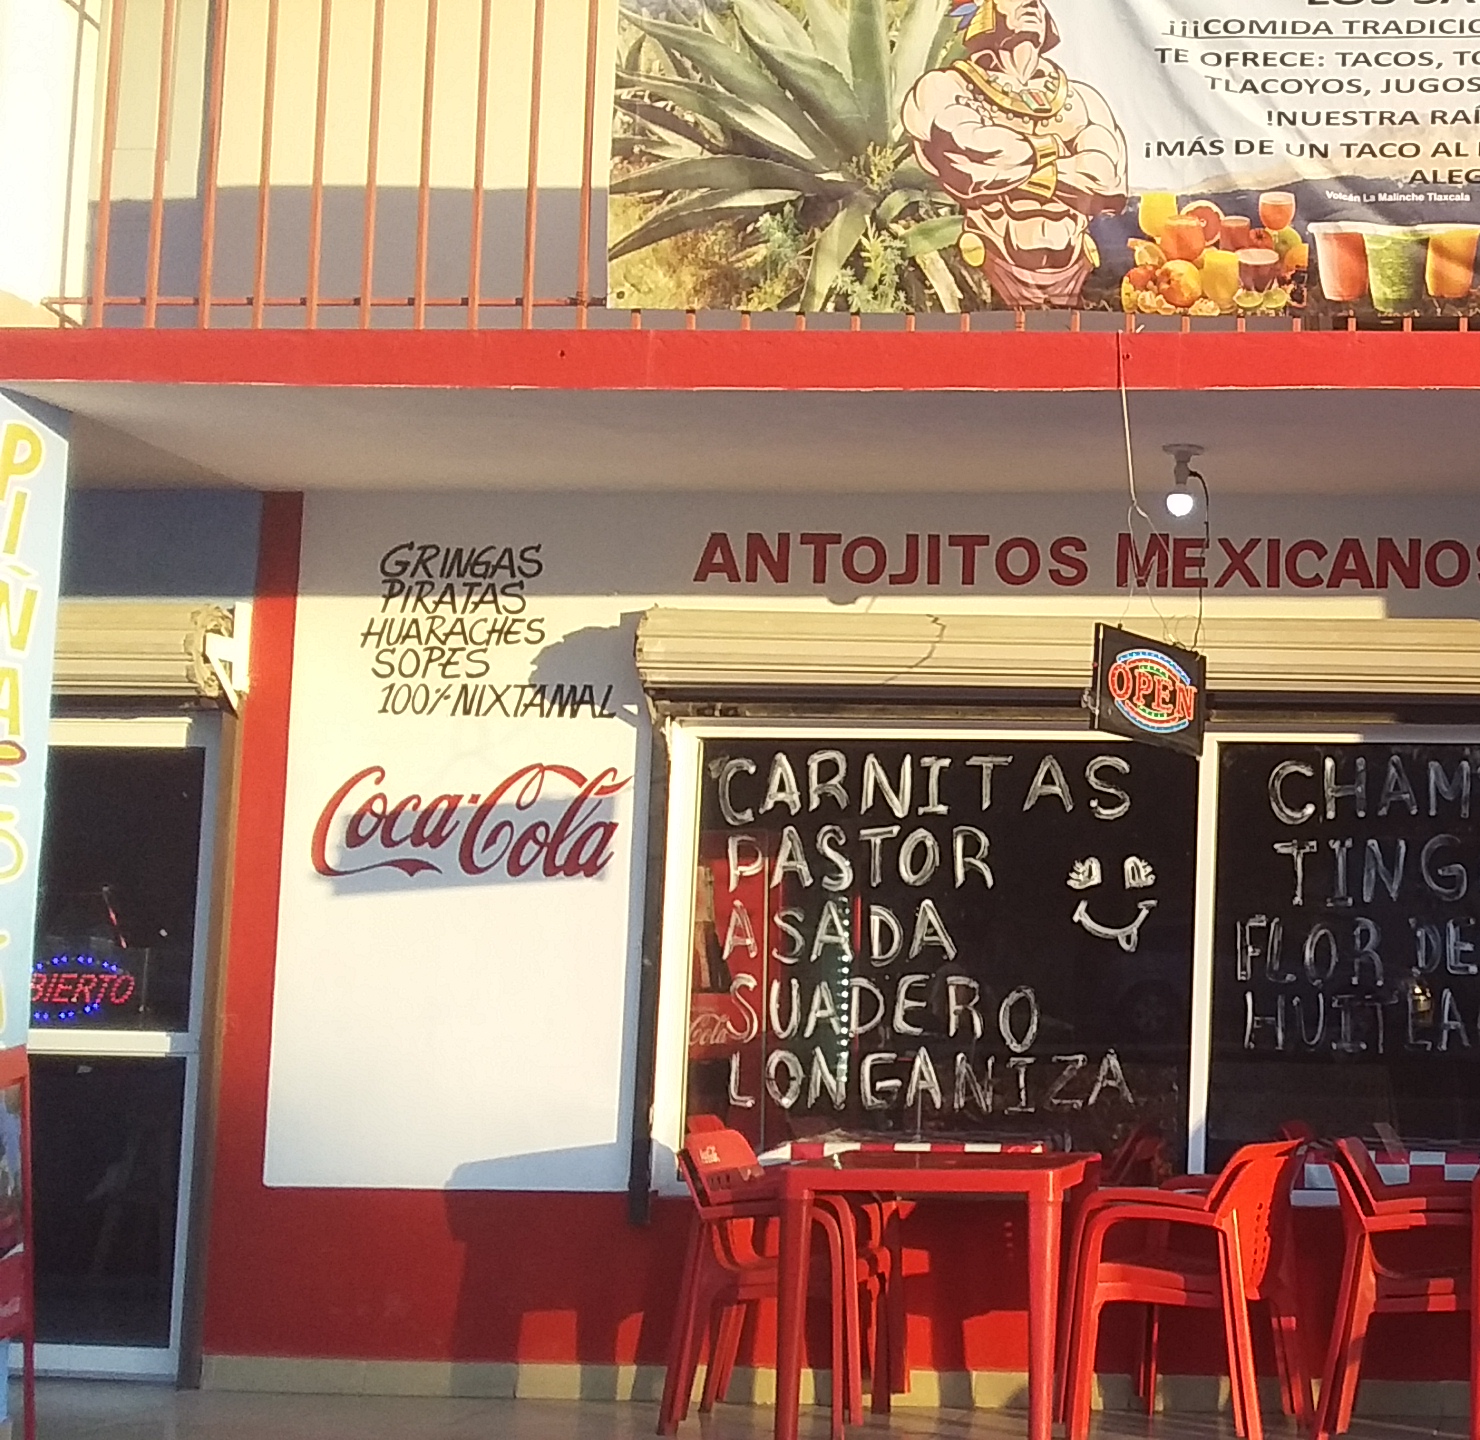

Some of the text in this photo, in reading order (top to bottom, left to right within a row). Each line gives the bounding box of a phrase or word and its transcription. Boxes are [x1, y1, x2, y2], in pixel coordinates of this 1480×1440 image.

[1154, 48, 1189, 64] TE
[1200, 51, 1325, 68] OFRECE:
[1335, 51, 1443, 70] TACOS,
[1204, 75, 1371, 97] TLACOYOS,
[1266, 110, 1420, 127] !NUESTRA
[1144, 136, 1225, 159] ¡MÁS
[1234, 138, 1274, 155] DE
[1285, 142, 1330, 159] UN
[1339, 142, 1421, 158] TACO
[1430, 141, 1470, 158] AL
[1363, 193, 1376, 203] La
[1427, 192, 1471, 203] Tlaxcala
[379, 541, 545, 579] GRINGAS
[693, 532, 1089, 587] ANTOJITOS
[380, 578, 527, 615] PIRATAS
[360, 615, 546, 649] HUARACHES
[371, 646, 490, 679] SOPES
[1108, 662, 1198, 721] OPEN
[714, 749, 1132, 826] CARNITAS
[310, 762, 635, 878] Coca-Cola
[727, 824, 995, 893] PASTOR
[722, 897, 958, 967] ASADA
[1236, 914, 1384, 986] FLOR
[30, 972, 136, 1005] BIERTO
[725, 973, 1039, 1054] SUADERO
[727, 1045, 1135, 1115] LONGANIZA
